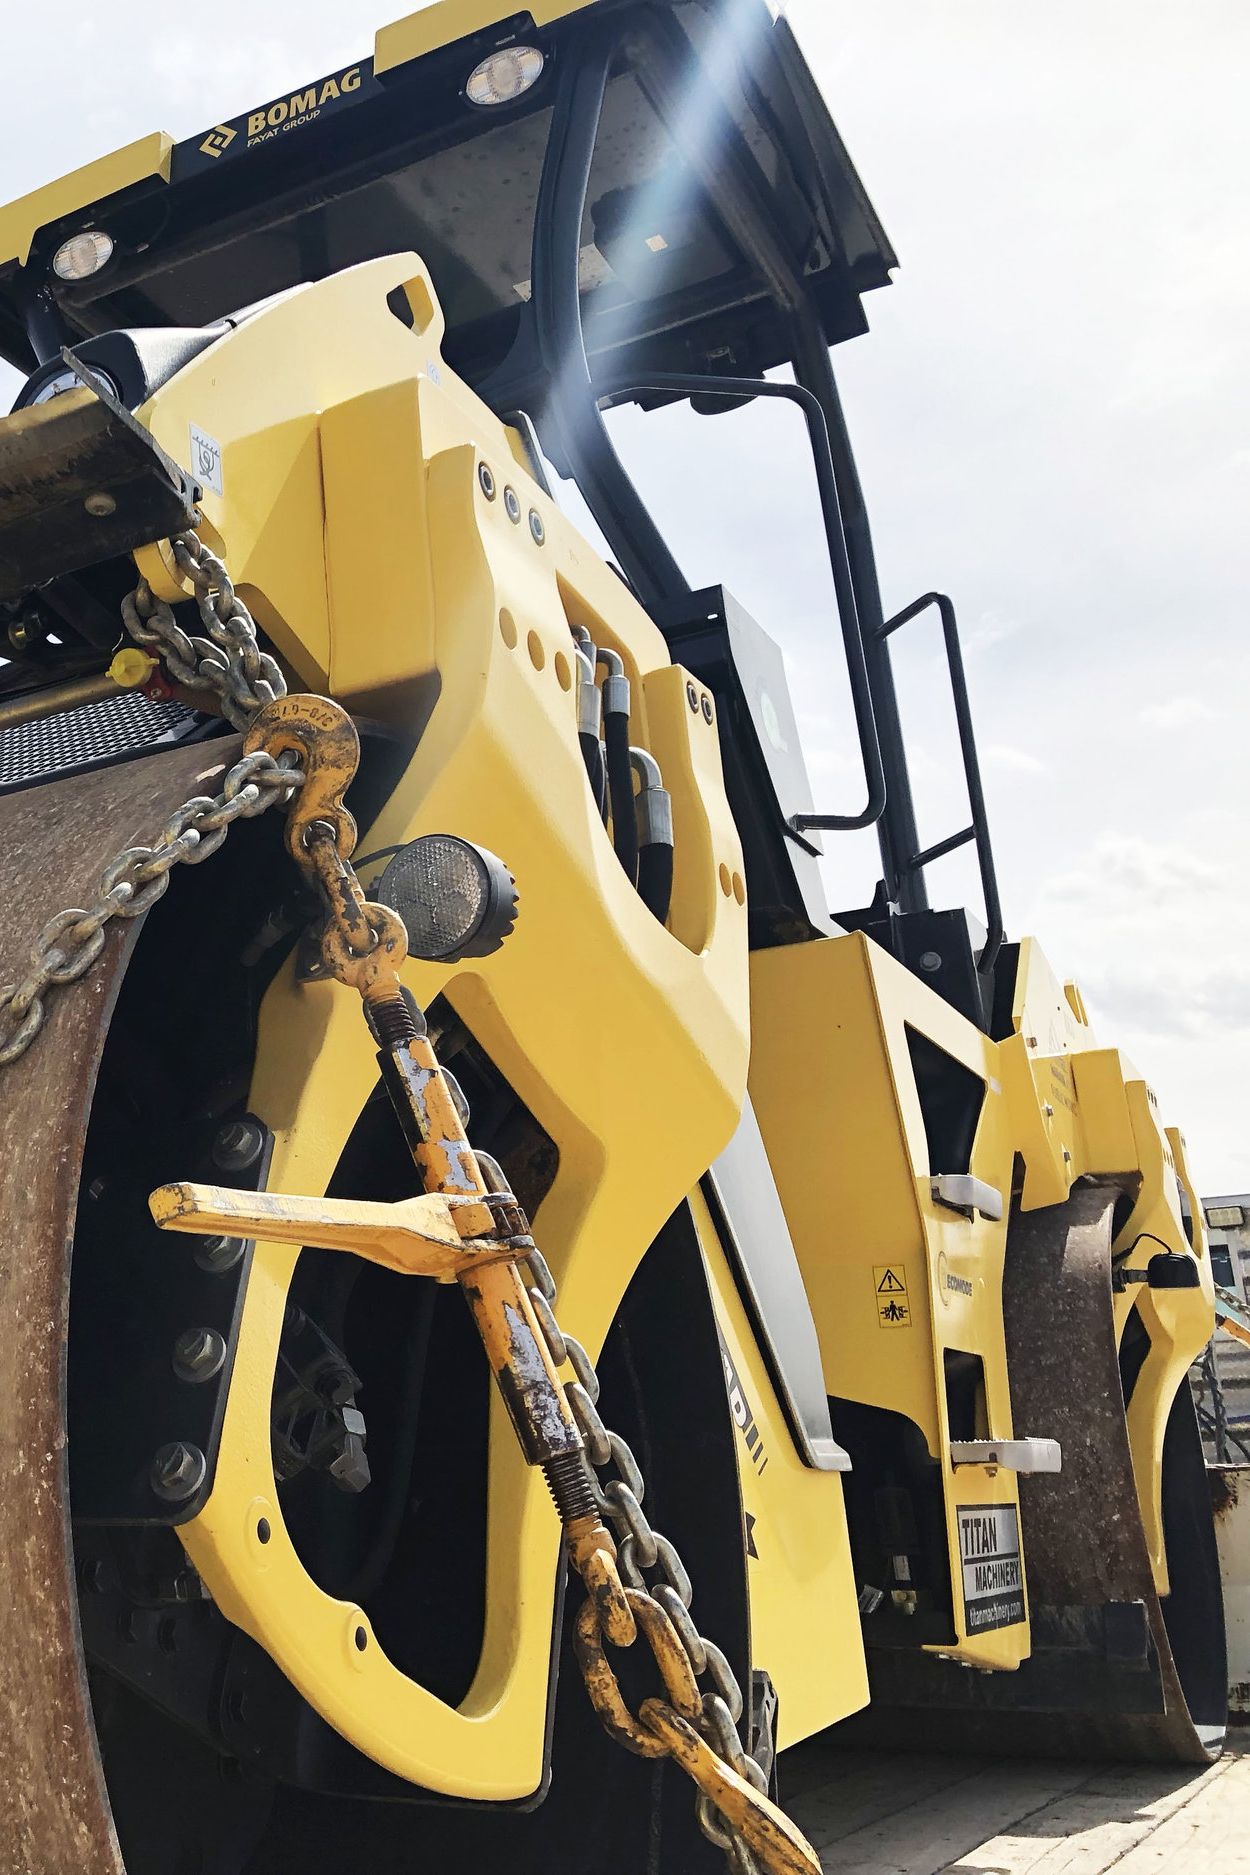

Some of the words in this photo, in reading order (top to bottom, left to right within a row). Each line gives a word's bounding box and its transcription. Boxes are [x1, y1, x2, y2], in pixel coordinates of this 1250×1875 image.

[247, 68, 361, 137] BOMAG
[247, 127, 280, 148] FAYAT
[282, 109, 321, 132] GROUP
[961, 1517, 997, 1556] TITAN
[975, 1560, 1019, 1593] MACHINERY
[969, 1600, 1022, 1627] titanmachinery.com
